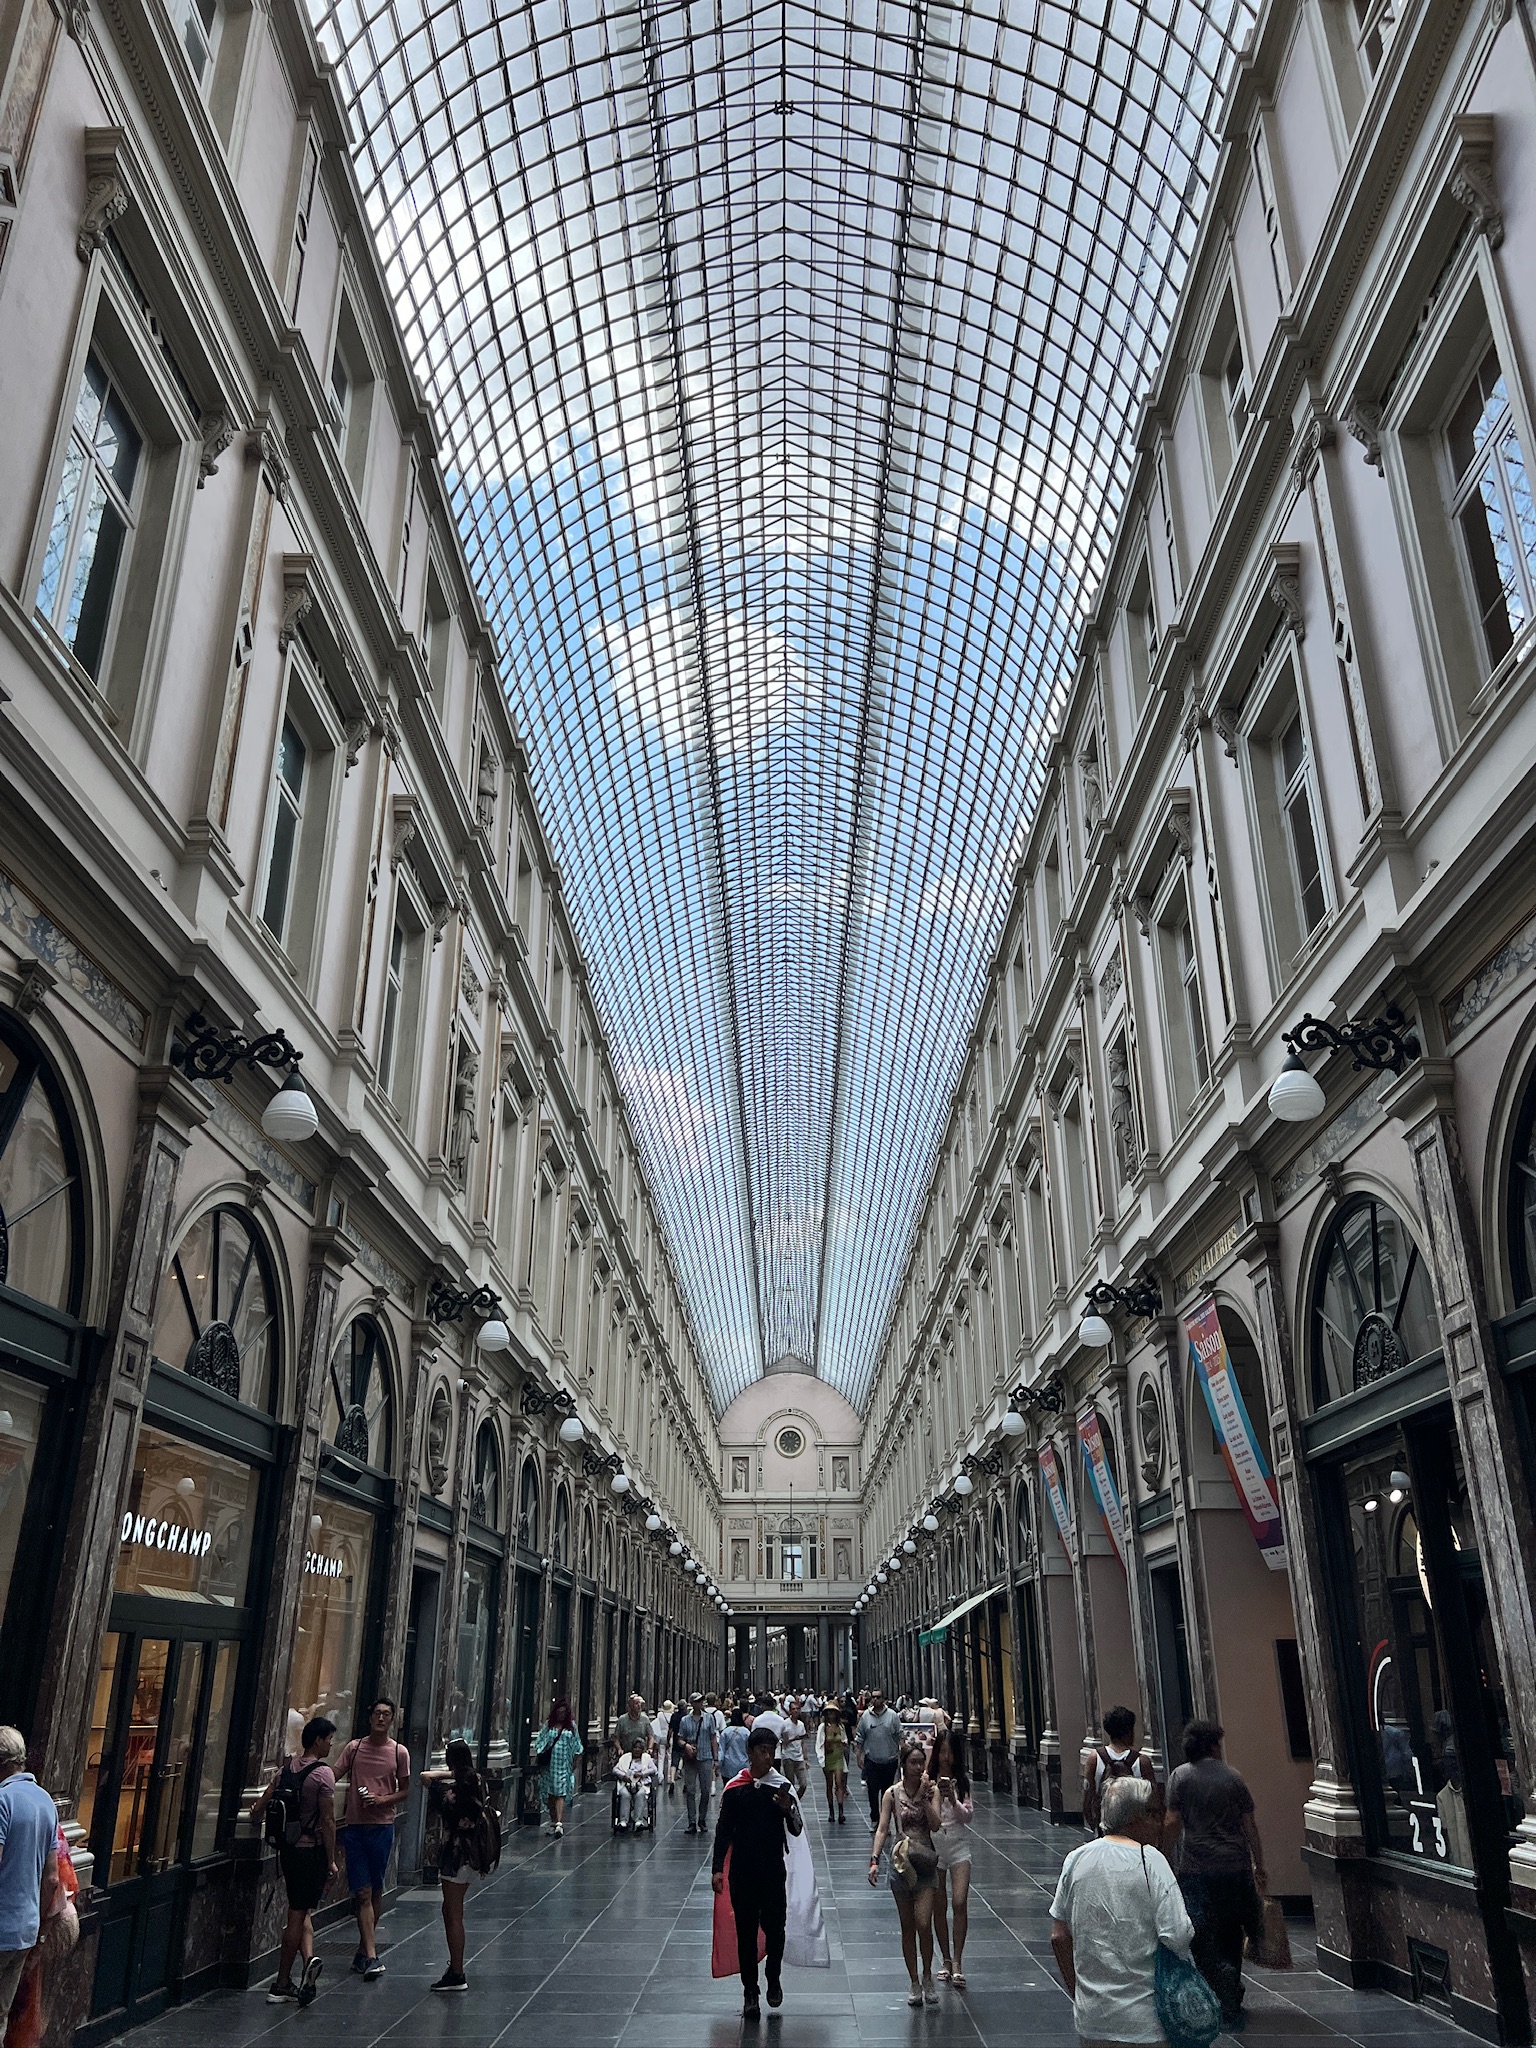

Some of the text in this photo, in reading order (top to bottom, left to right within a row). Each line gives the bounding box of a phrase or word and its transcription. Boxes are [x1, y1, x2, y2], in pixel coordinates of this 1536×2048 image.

[1200, 1225, 1238, 1275] GALERIES
[1194, 1330, 1223, 1363] Saison
[121, 1511, 212, 1557] ONGCHAMP
